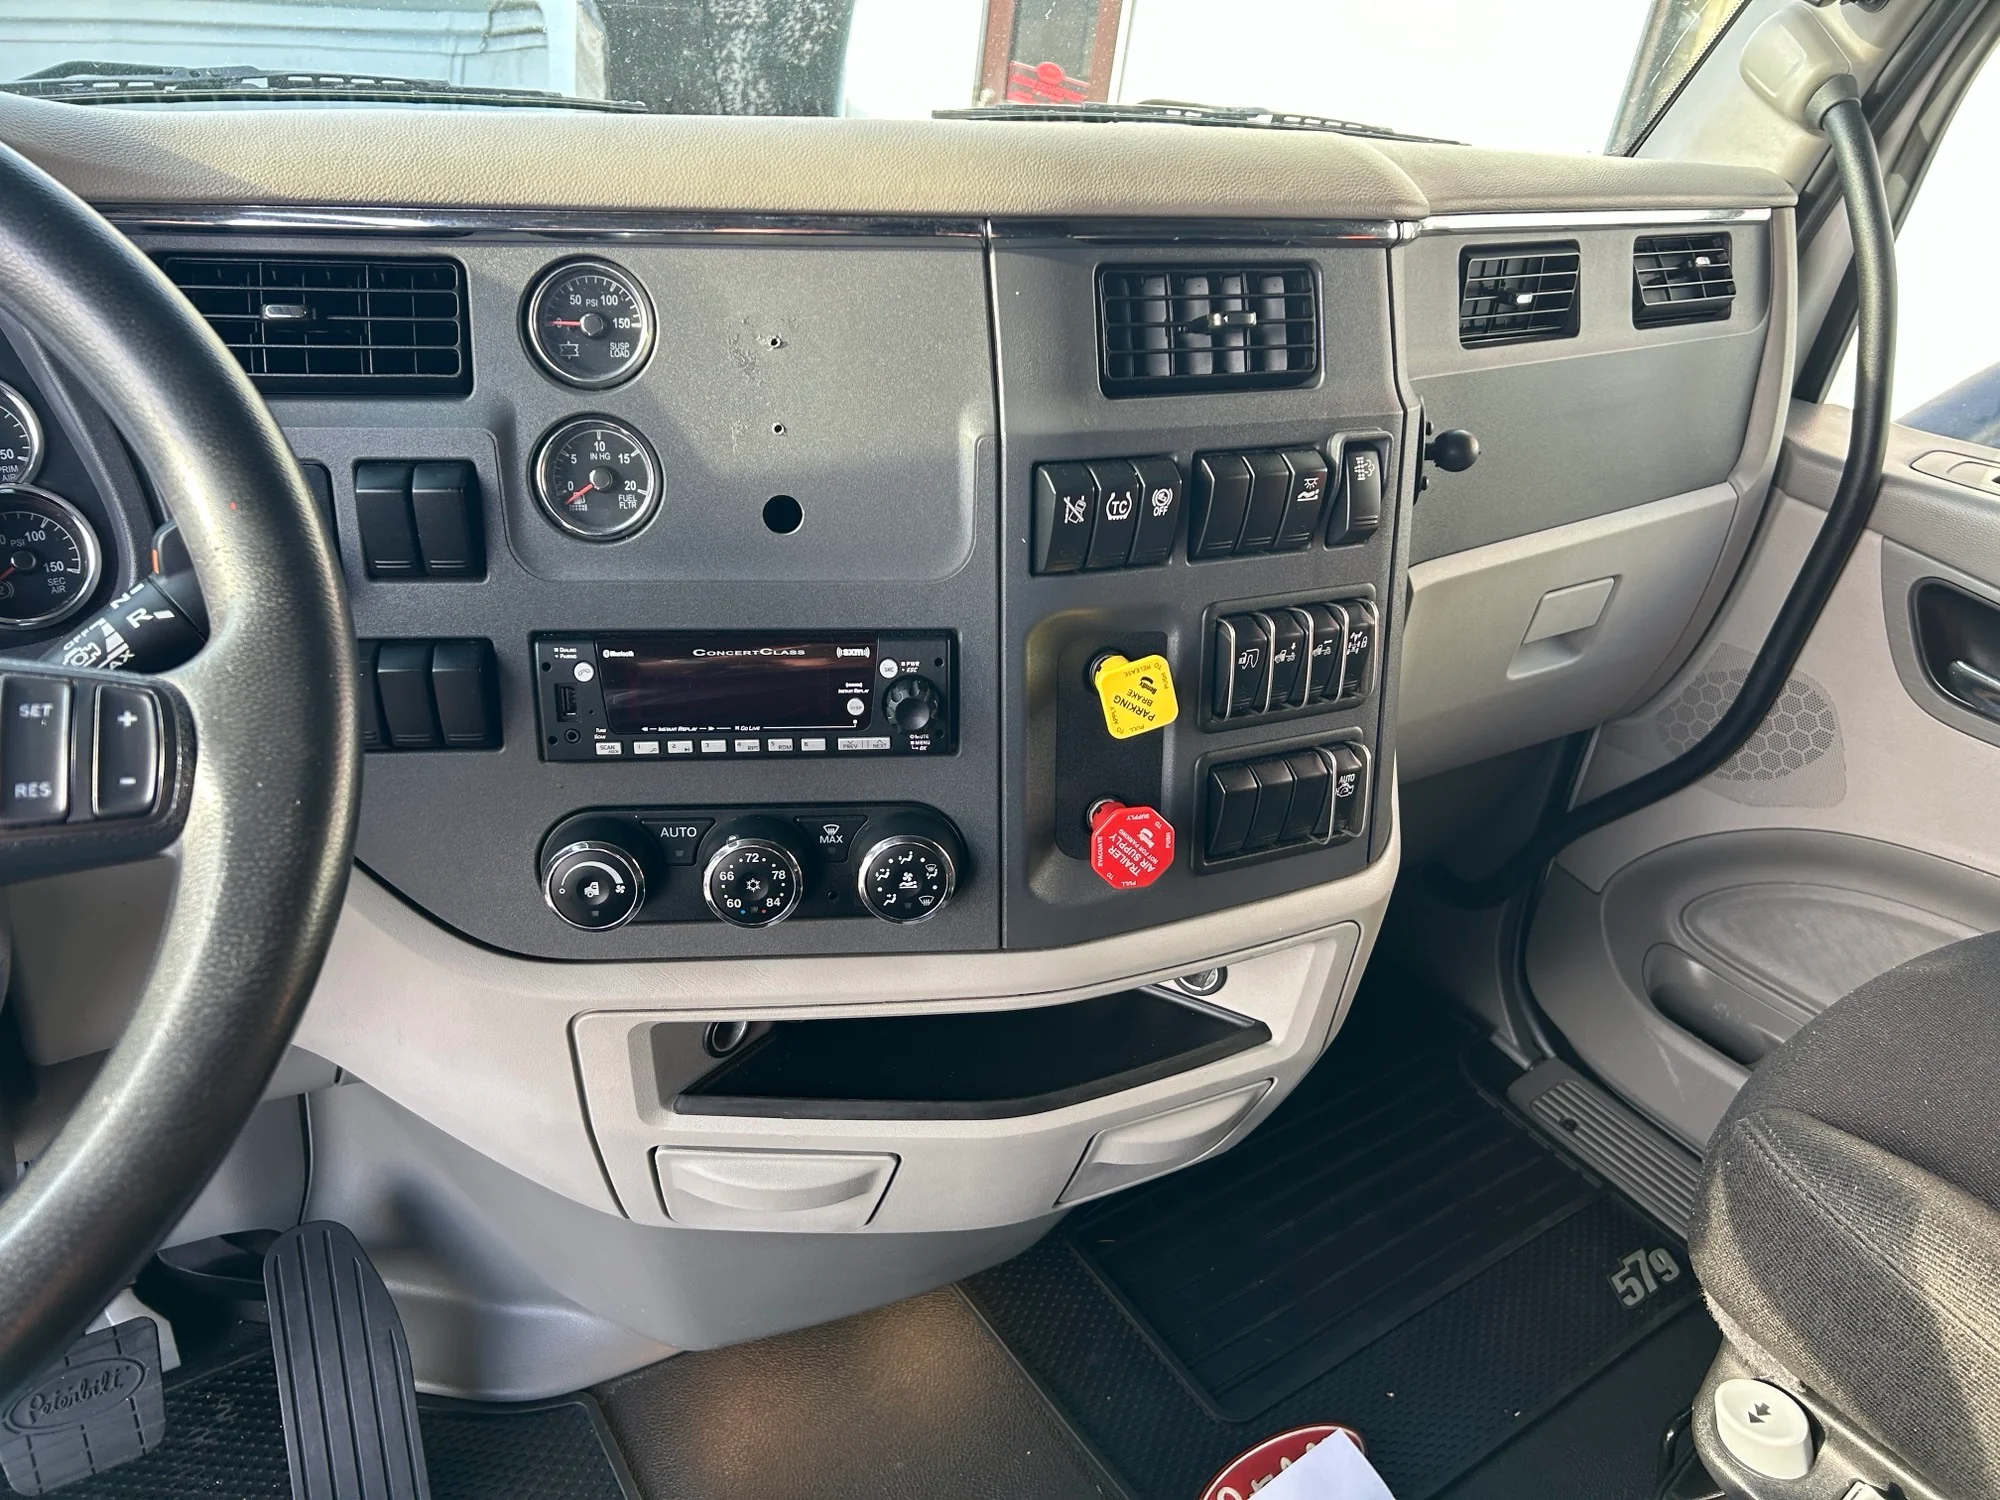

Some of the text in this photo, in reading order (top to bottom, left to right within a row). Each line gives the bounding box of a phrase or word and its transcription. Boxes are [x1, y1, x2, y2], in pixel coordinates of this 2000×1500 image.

[569, 294, 618, 307] 50 PSI 100
[612, 318, 631, 329] 150
[609, 342, 630, 350] SUSP
[609, 350, 630, 358] LOAD
[594, 441, 606, 452] 10
[0, 449, 15, 460] 50
[570, 454, 577, 464] 5
[599, 452, 611, 460] HG
[618, 453, 631, 464] 15
[2, 473, 17, 482] AIR
[567, 481, 574, 492] 0
[624, 480, 637, 491] 20
[618, 494, 638, 502] FUEL
[619, 501, 637, 510] FLTR
[1111, 500, 1128, 514] TC
[1153, 506, 1169, 517] OFF
[10, 537, 25, 548] PSI
[25, 530, 46, 543] 100
[43, 560, 64, 573] 150
[47, 577, 66, 587] SEC
[51, 585, 66, 595] AIR
[110, 592, 131, 610] N
[126, 607, 154, 629] R
[109, 649, 135, 670] AX
[1123, 662, 1169, 690] PUSH TO RELEASE
[1127, 688, 1154, 707] BRAKE
[19, 702, 54, 718] SET
[1113, 695, 1156, 721] PARKING
[1110, 706, 1119, 724] APPLY
[1129, 724, 1145, 733] PULL
[1338, 773, 1356, 784] AUTO
[14, 781, 52, 798] RES
[1126, 813, 1150, 821] SUPPLY
[1154, 820, 1163, 829] TO
[660, 826, 697, 839] AUTO
[819, 833, 843, 844] MAX
[1118, 828, 1159, 865] NOT FOR PARKING
[744, 852, 760, 863] 72
[1108, 833, 1156, 873] AIR SUPPLY
[1108, 845, 1141, 877] TRAILER
[719, 870, 735, 882] 66
[771, 869, 786, 881] 78
[1106, 872, 1115, 880] TO
[726, 898, 742, 909] 60
[765, 897, 781, 908] 84
[1610, 1247, 1680, 1307] 579
[29, 1366, 129, 1425] Peterbilt
